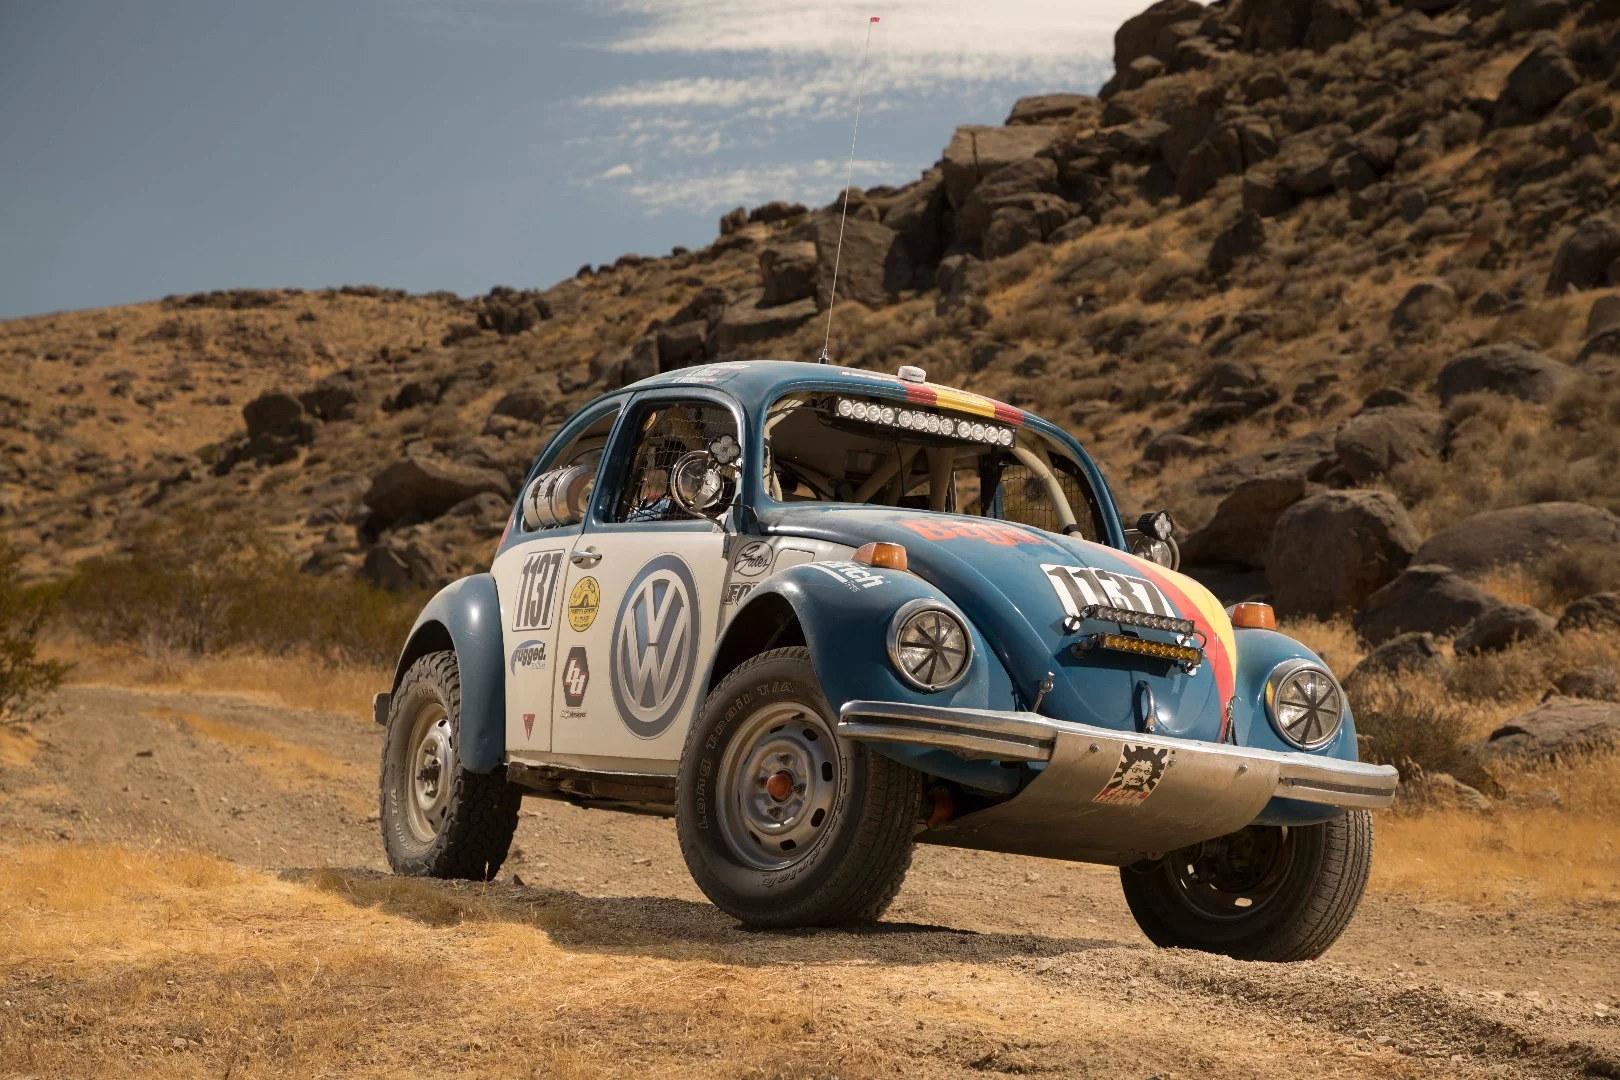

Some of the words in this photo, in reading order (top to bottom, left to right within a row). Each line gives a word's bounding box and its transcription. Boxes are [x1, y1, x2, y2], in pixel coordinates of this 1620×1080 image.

[734, 545, 770, 572] Gates
[516, 553, 561, 627] 1137
[724, 582, 760, 605] FO
[1047, 566, 1169, 617] 1137
[696, 758, 712, 829] Long
[706, 693, 752, 749] Trail
[757, 681, 795, 696] T/A
